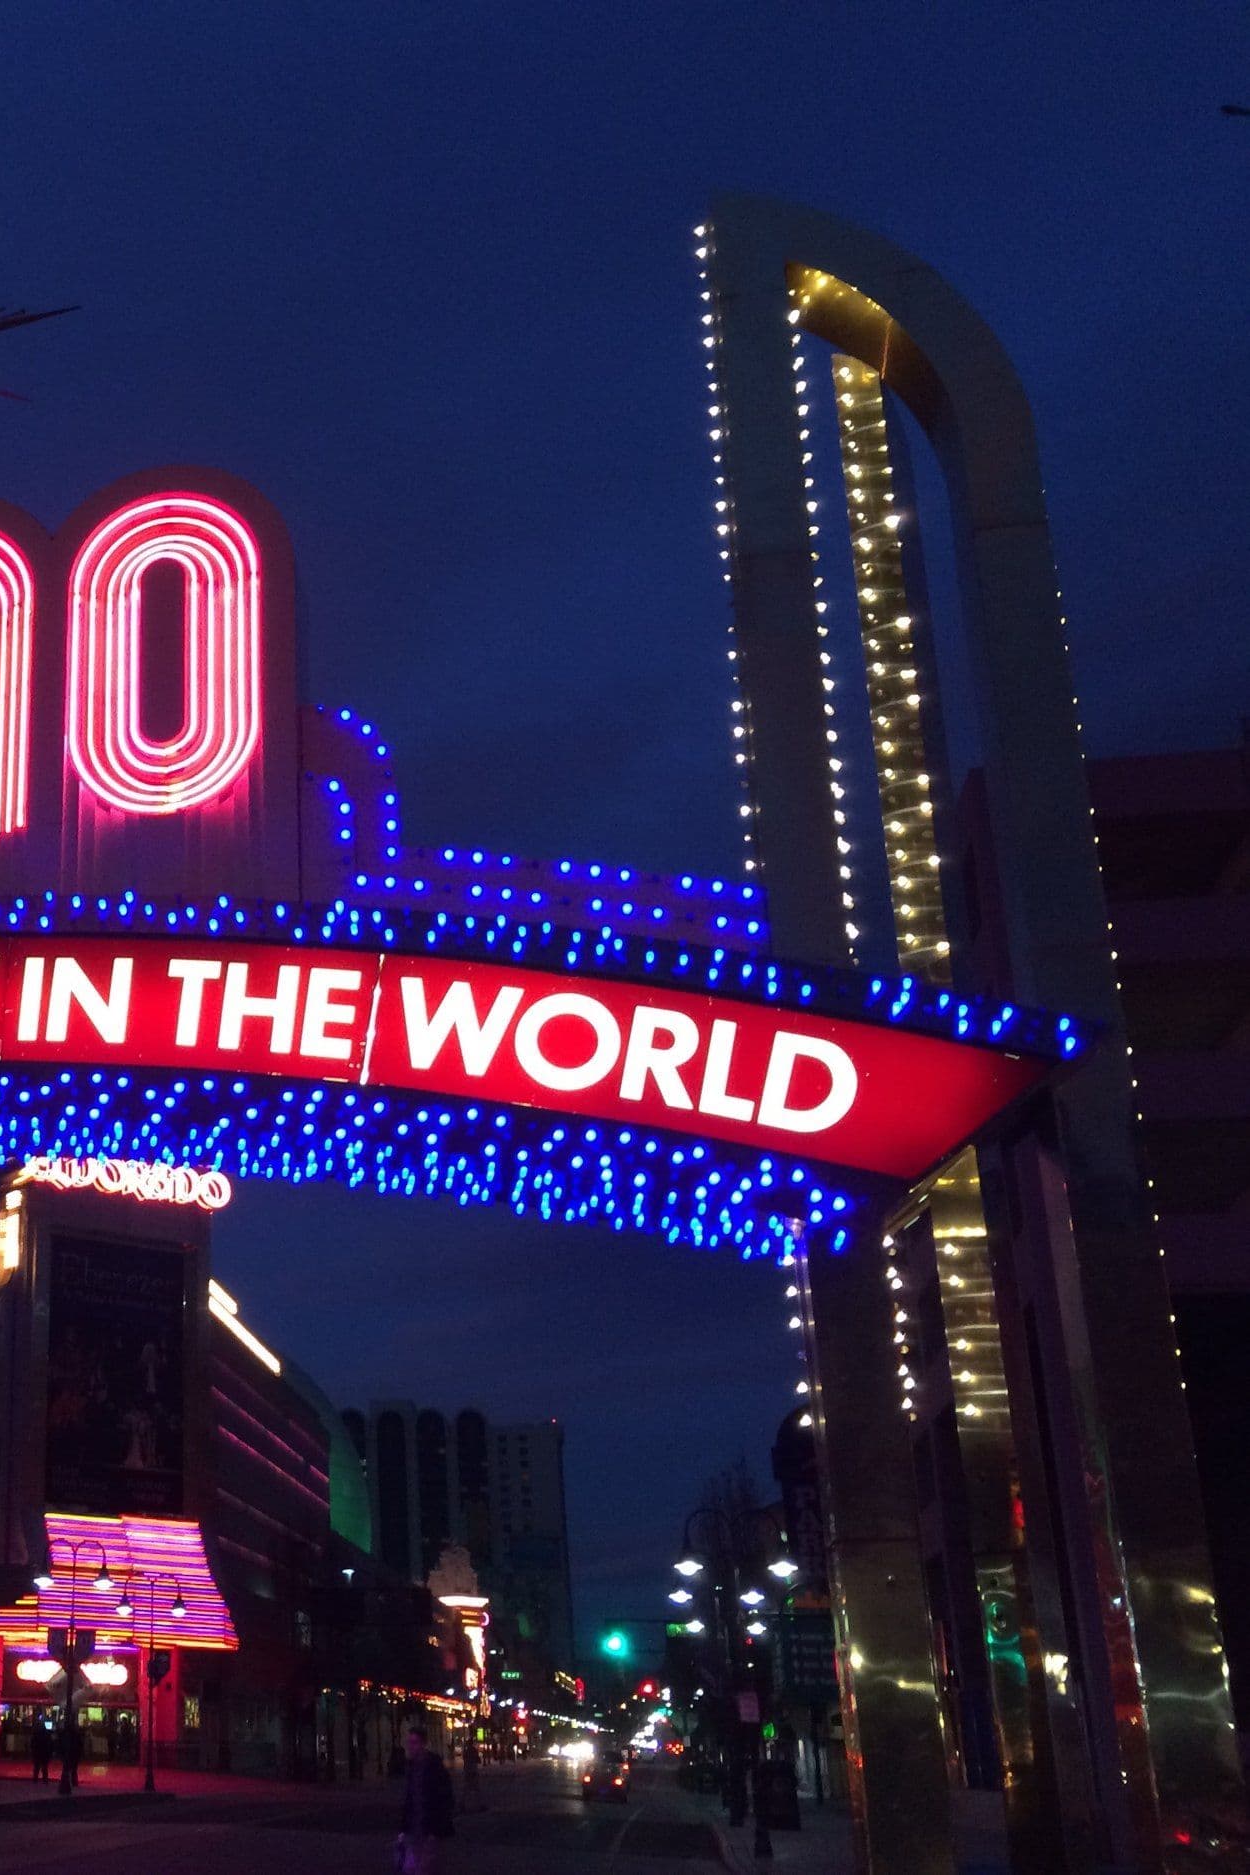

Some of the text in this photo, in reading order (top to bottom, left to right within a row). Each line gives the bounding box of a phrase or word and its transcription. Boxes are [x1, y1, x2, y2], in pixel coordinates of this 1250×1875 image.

[17, 957, 134, 1044] IN
[167, 958, 362, 1060] THE
[400, 976, 858, 1133] WORLD
